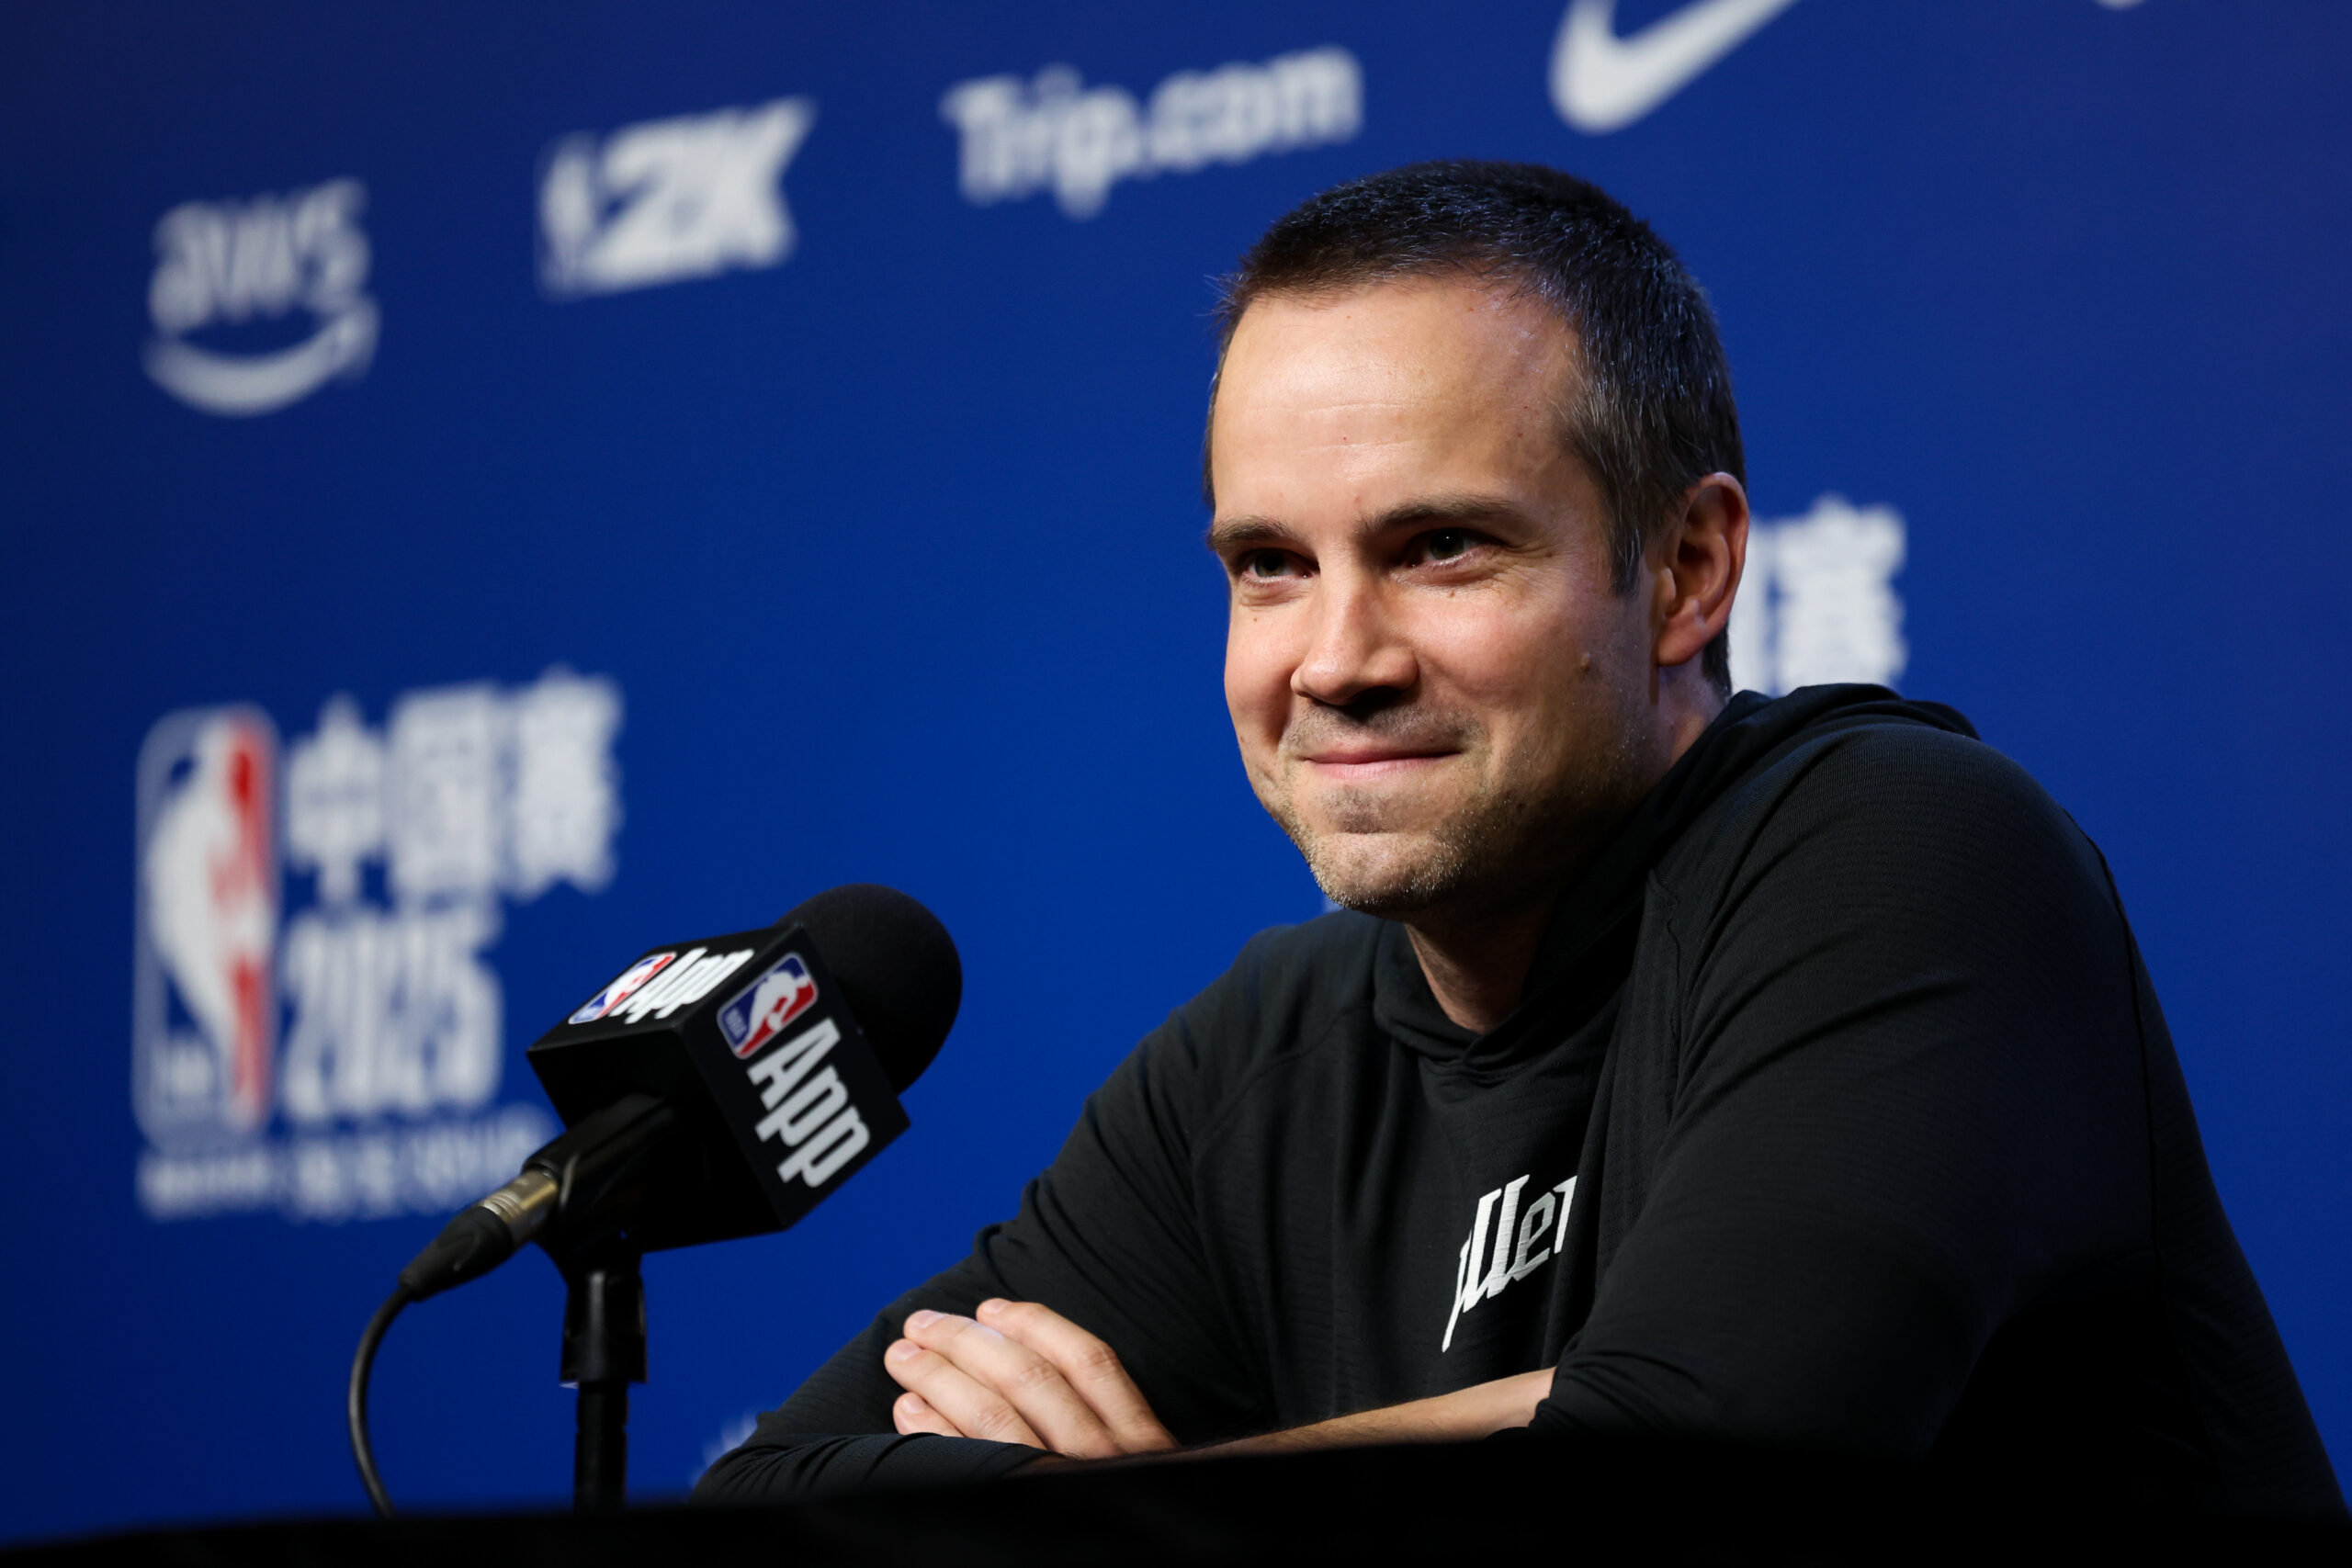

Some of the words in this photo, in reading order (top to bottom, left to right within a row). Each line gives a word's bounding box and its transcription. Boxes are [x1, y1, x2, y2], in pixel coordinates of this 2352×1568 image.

[941, 48, 1363, 220] Trip.com
[150, 180, 369, 333] aws
[287, 669, 623, 905] 中国赛
[287, 909, 502, 1122] 2025
[608, 947, 754, 1024] App
[747, 1018, 870, 1188] App
